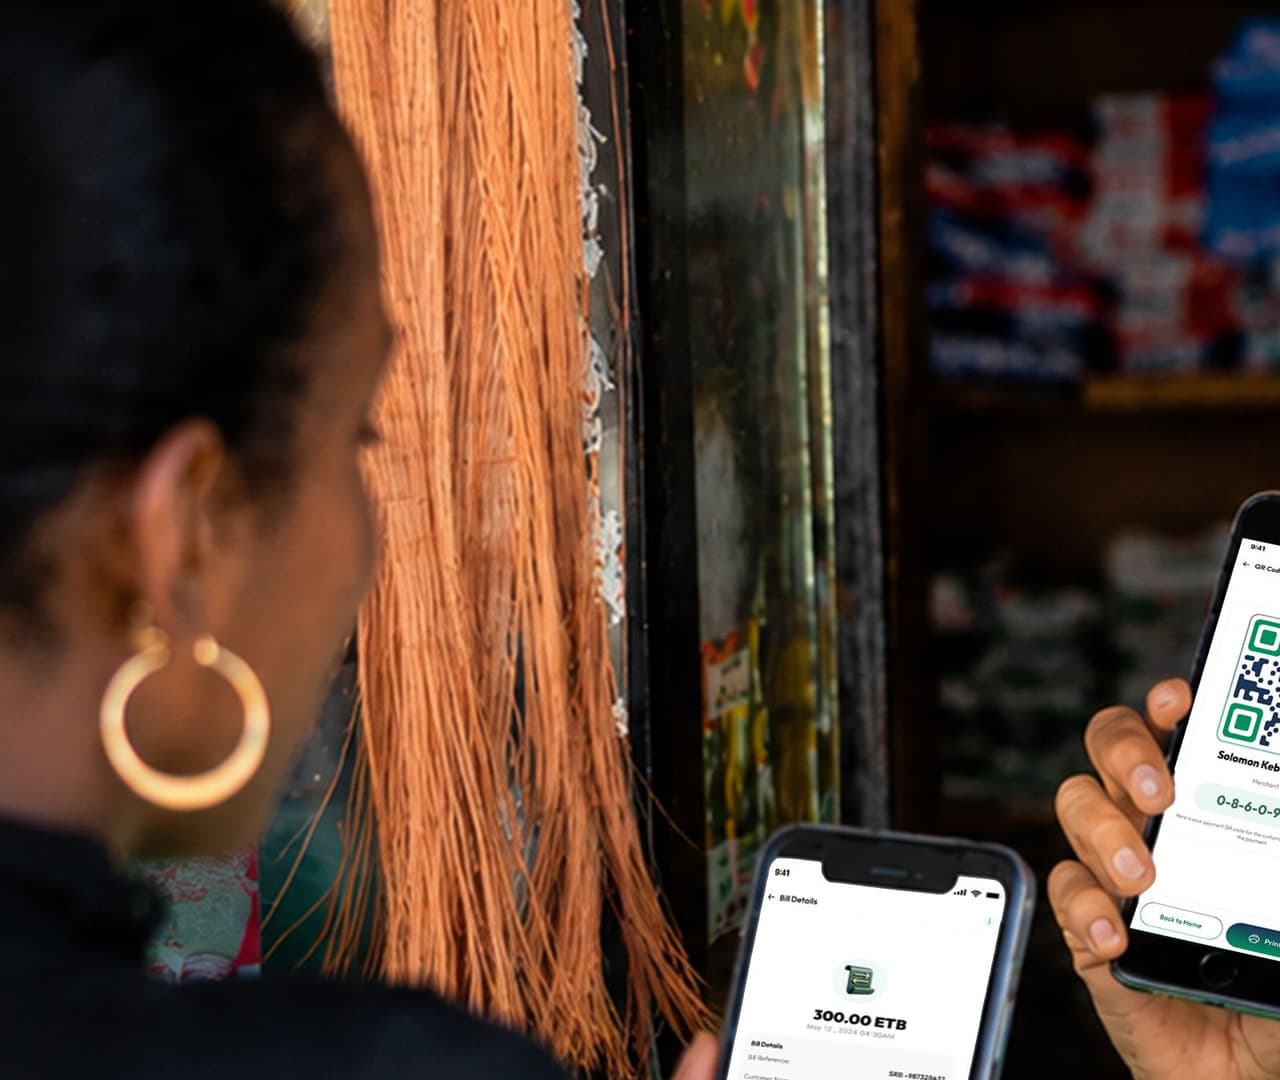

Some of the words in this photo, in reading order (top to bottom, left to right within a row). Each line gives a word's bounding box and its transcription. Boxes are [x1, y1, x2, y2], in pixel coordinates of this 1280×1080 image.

[1250, 543, 1266, 552] 9:41
[1254, 563, 1266, 571] QR
[1217, 750, 1260, 768] Solomon
[1252, 778, 1279, 790] Merchant
[774, 868, 790, 877] 9:41
[779, 894, 791, 902] Bill
[791, 895, 818, 905] Details
[1159, 913, 1175, 922] Back
[1183, 919, 1202, 929] Home
[813, 1009, 872, 1026] 300.00
[874, 1016, 907, 1030] ETB
[806, 1023, 822, 1032] May
[760, 1041, 783, 1049] Details
[743, 1073, 773, 1080] Customer
